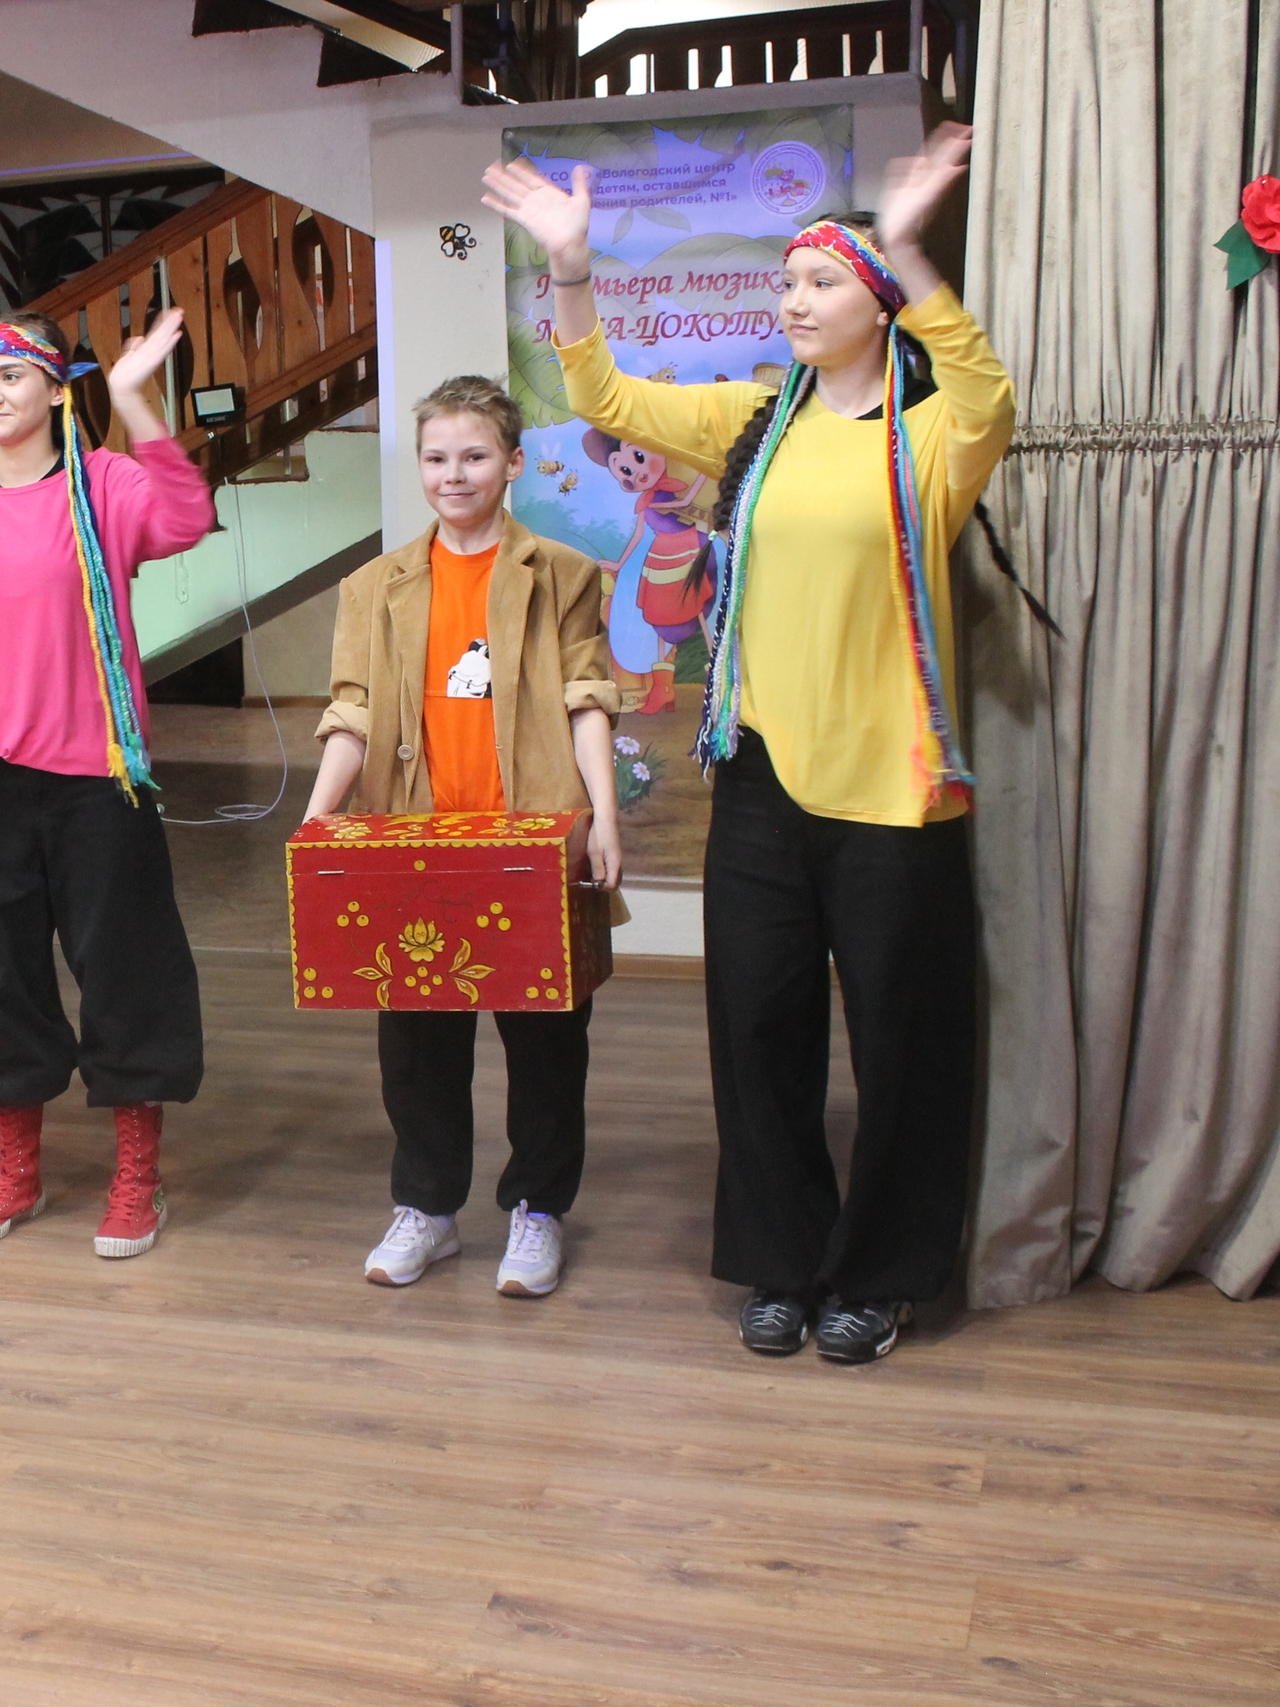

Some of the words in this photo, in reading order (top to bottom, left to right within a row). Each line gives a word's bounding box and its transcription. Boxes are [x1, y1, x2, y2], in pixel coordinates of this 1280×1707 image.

[550, 171, 569, 182] СО
[595, 163, 690, 179] «Вологодский
[694, 161, 736, 177] центр
[596, 184, 640, 196] детям,
[642, 178, 727, 193] оставшимся
[630, 194, 708, 209] родителей,
[710, 192, 738, 202] №1»
